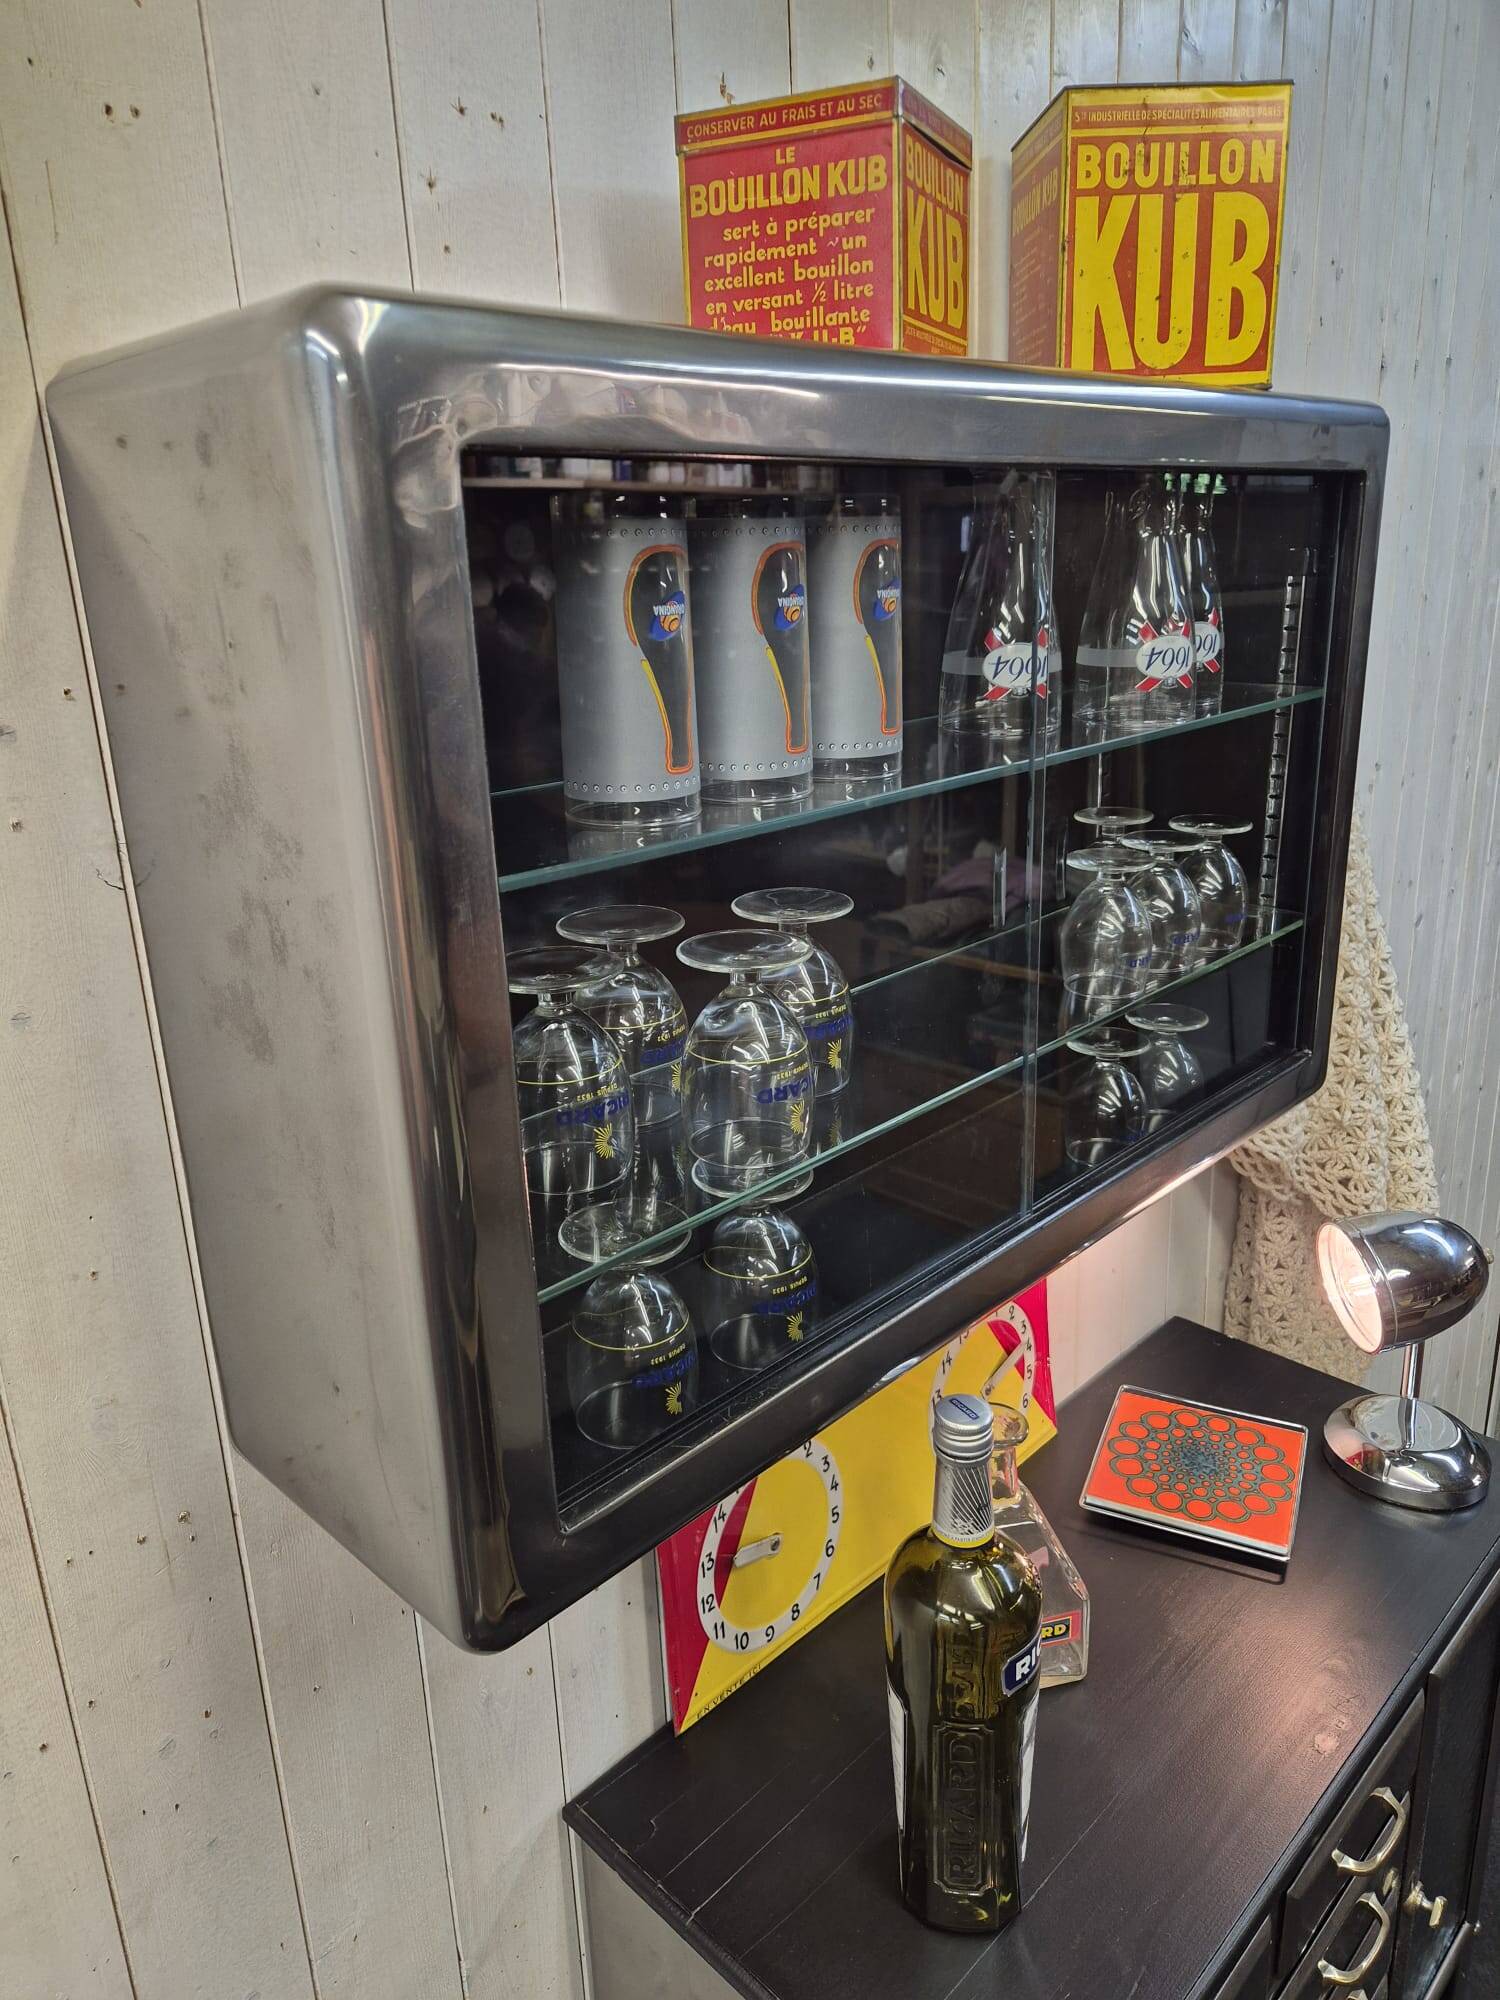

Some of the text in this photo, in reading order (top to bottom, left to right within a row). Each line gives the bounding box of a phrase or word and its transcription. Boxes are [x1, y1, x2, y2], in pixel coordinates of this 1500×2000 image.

[687, 93, 882, 138] CONSERVER AU FRAIS ET AU SEC
[1088, 109, 1140, 122] INDUSTRIELLE
[775, 146, 796, 165] LE
[1076, 137, 1277, 190] BOUILLON
[906, 134, 964, 215] BOUILLON
[689, 154, 888, 218] BOUILLON KUB
[723, 207, 875, 242] sert à préparer
[704, 235, 867, 275] rapidement un
[907, 185, 964, 330] KUB
[704, 253, 874, 292] excellent bouillon
[1071, 191, 1270, 371] KUB
[706, 302, 727, 316] en
[733, 289, 803, 313] versant
[834, 279, 874, 301] litre
[770, 305, 870, 333] bouillante
[988, 654, 1047, 682] 1664
[1144, 646, 1190, 673] 1664
[1008, 1305, 1015, 1320] 2
[1021, 1319, 1027, 1334] 3
[1026, 1338, 1033, 1351] 4
[942, 1350, 952, 1375] 14
[1026, 1363, 1033, 1379] 5
[1022, 1393, 1029, 1408] 6
[804, 1439, 813, 1458] 2
[821, 1455, 830, 1472] 3
[830, 1474, 839, 1492] 4
[713, 1504, 727, 1533] 14
[831, 1505, 840, 1523] 5
[825, 1538, 835, 1557] 6
[701, 1551, 715, 1578] 13
[813, 1573, 821, 1591] 7
[701, 1593, 715, 1614] 12
[791, 1603, 800, 1621] 8
[713, 1621, 725, 1640] 11
[734, 1631, 749, 1650] 10
[765, 1625, 775, 1643] 9
[1041, 1623, 1067, 1638] RD
[949, 1738, 977, 1880] RICARD
